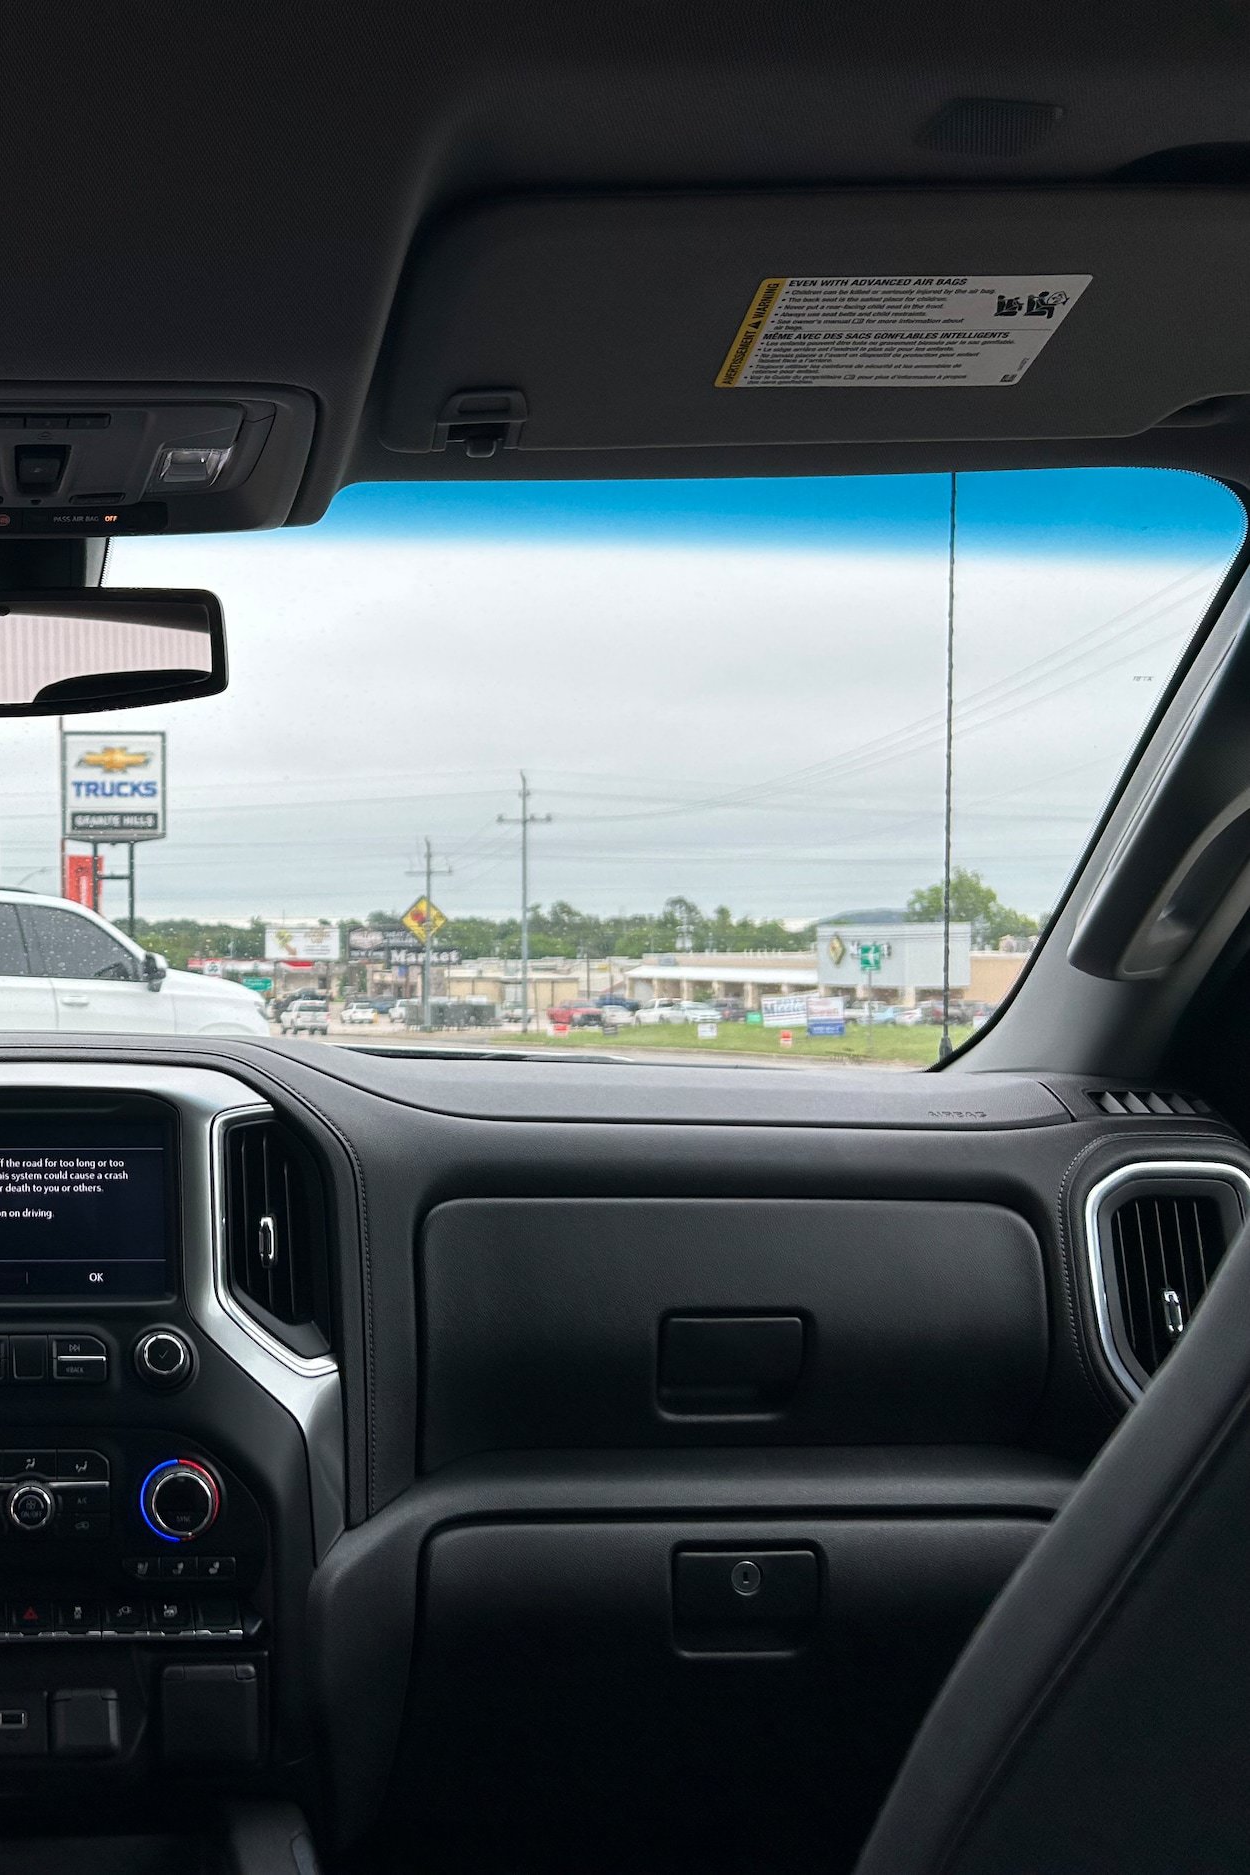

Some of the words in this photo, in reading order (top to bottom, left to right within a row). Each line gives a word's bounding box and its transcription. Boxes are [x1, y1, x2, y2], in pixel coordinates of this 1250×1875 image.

[913, 278, 934, 286] AIR
[936, 278, 968, 286] BAGS
[752, 283, 780, 319] WARNING
[845, 332, 872, 340] SACS
[874, 332, 939, 340] GONFLABLES
[940, 332, 1010, 340] INTELLIGENTS
[72, 781, 158, 798] TRUCKS
[390, 949, 461, 964] Market
[6, 1158, 20, 1168] the
[23, 1158, 42, 1168] road
[45, 1158, 57, 1168] for
[60, 1159, 74, 1168] too
[76, 1158, 95, 1169] long
[98, 1160, 107, 1168] or
[109, 1159, 124, 1168] too
[11, 1172, 42, 1182] system
[44, 1170, 67, 1180] could
[104, 1171, 128, 1180] crash
[5, 1183, 30, 1193] death
[33, 1185, 42, 1193] to
[44, 1186, 59, 1195] you
[73, 1183, 104, 1193] others.
[89, 1272, 105, 1283] OK
